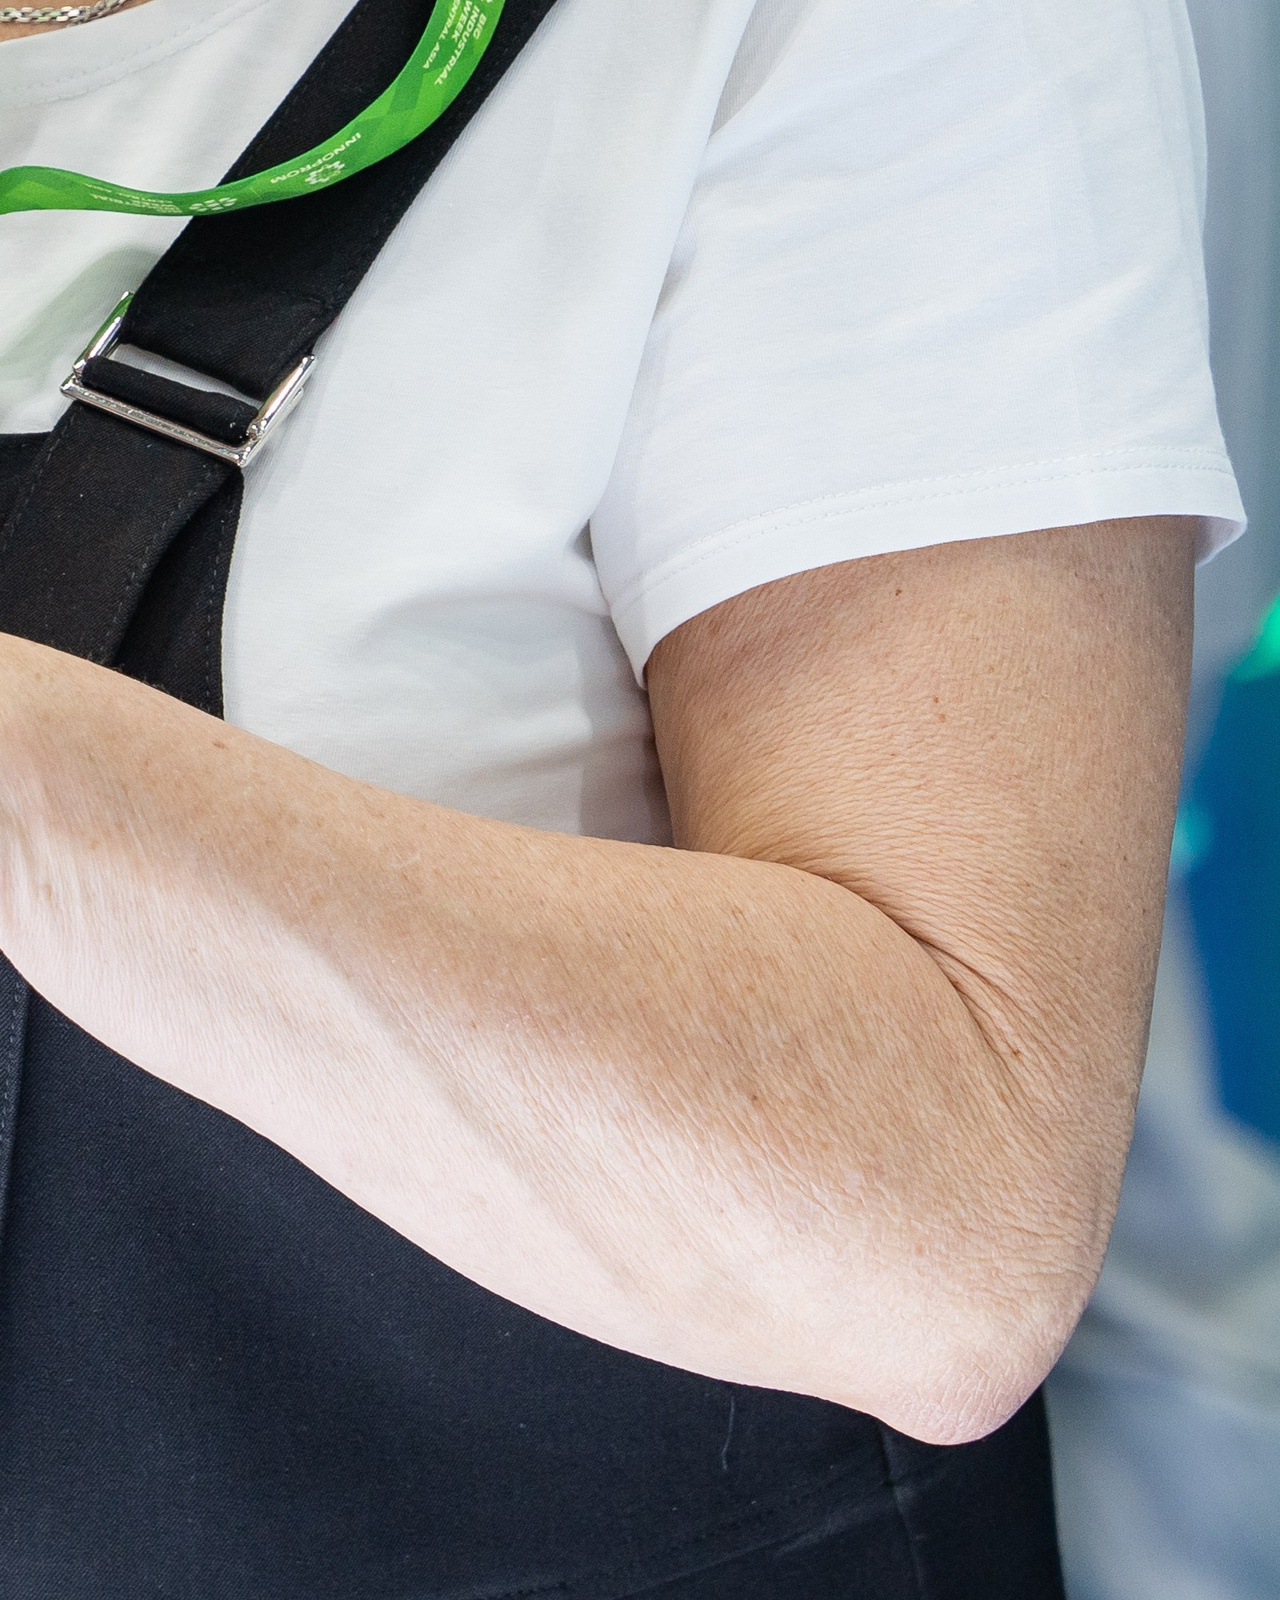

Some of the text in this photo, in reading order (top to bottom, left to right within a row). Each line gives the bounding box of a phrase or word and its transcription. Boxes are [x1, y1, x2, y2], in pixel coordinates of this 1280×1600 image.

[452, 0, 473, 43] WEEK
[473, 13, 487, 40] BIG
[423, 41, 440, 69] ASIA
[434, 5, 480, 85] INDUSTRIAL
[270, 132, 361, 184] INNOPROM
